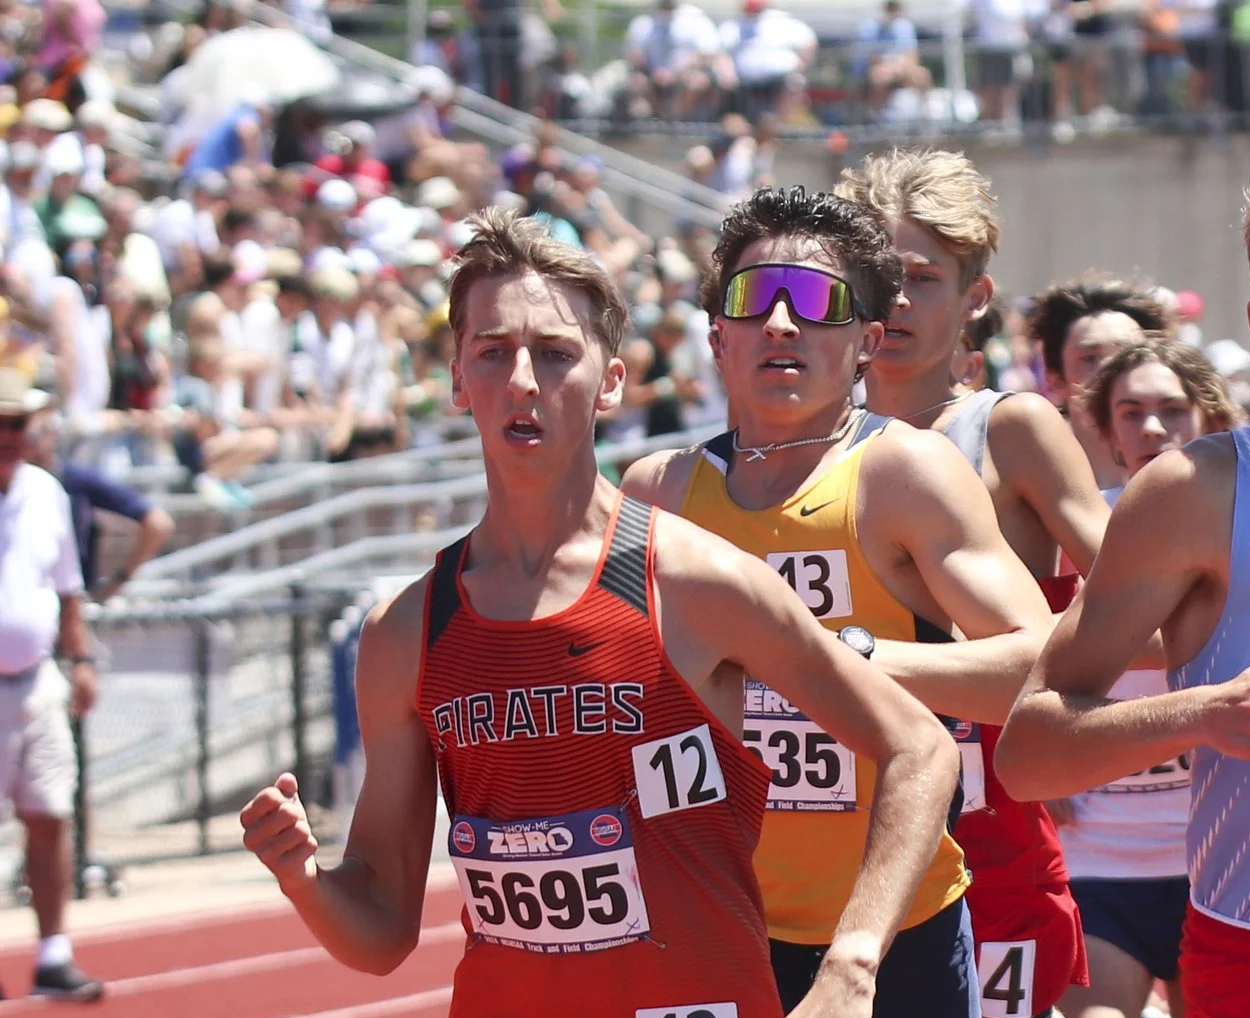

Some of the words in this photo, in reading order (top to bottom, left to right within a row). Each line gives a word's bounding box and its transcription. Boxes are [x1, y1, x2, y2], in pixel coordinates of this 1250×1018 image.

[432, 682, 645, 752] PIRATES
[649, 734, 719, 809] 12
[487, 827, 574, 854] ZERO
[503, 821, 550, 834] SHOW-ME
[465, 863, 629, 930] 5695
[547, 944, 560, 953] and
[563, 943, 581, 953] Field
[983, 946, 1026, 1015] 4
